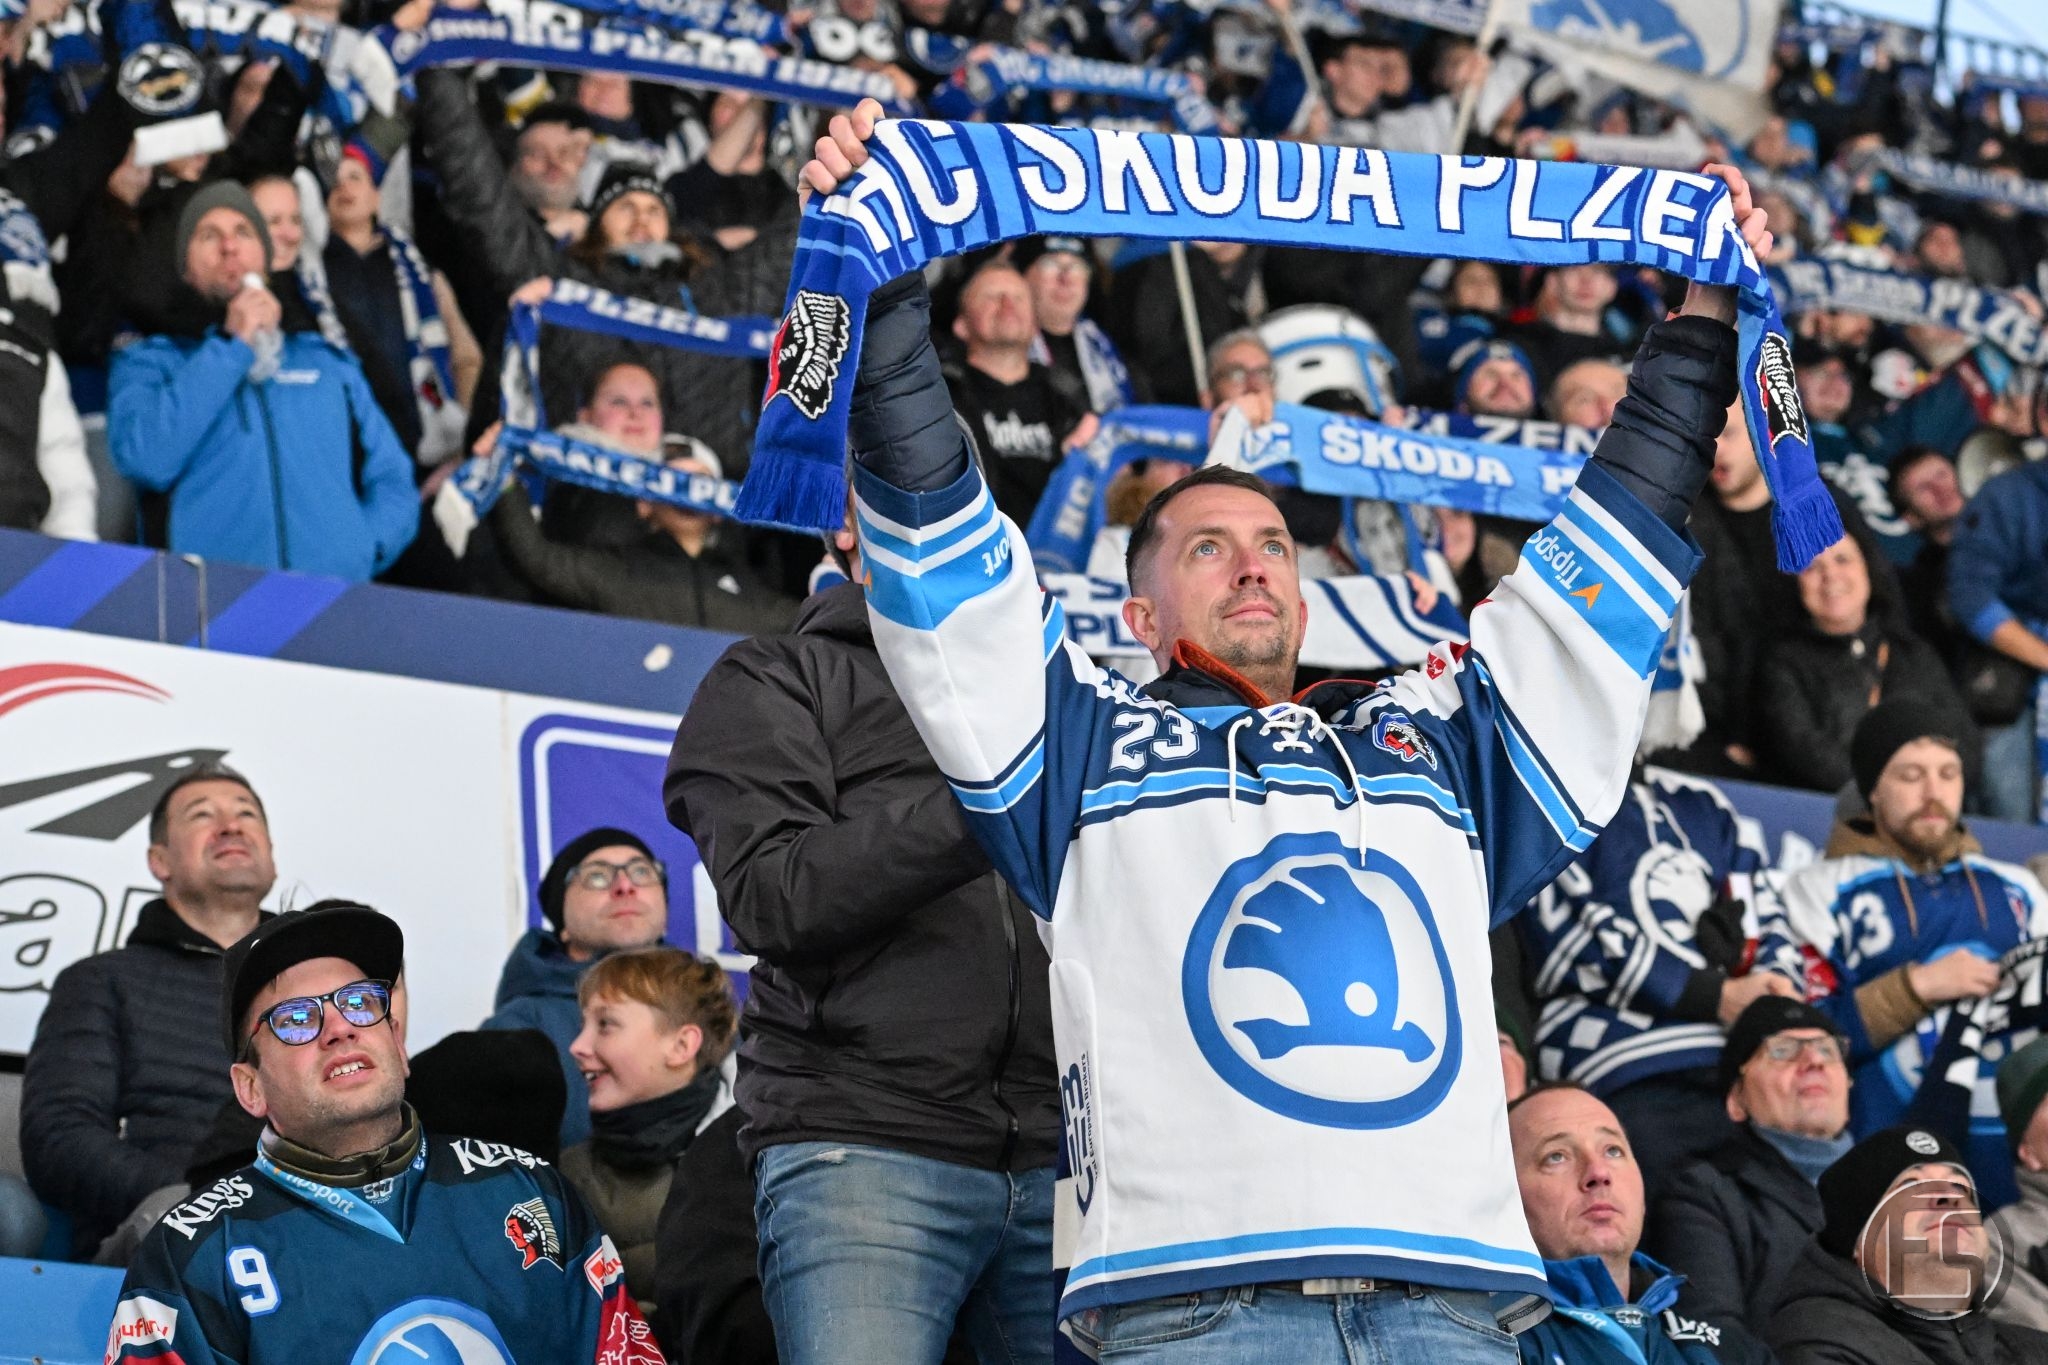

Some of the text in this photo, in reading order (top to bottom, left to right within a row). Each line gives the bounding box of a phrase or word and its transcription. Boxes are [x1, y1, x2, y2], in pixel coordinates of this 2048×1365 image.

[1108, 709, 1200, 773] 23
[1080, 1053, 1090, 1101] Brokers
[228, 1246, 281, 1317] 9
